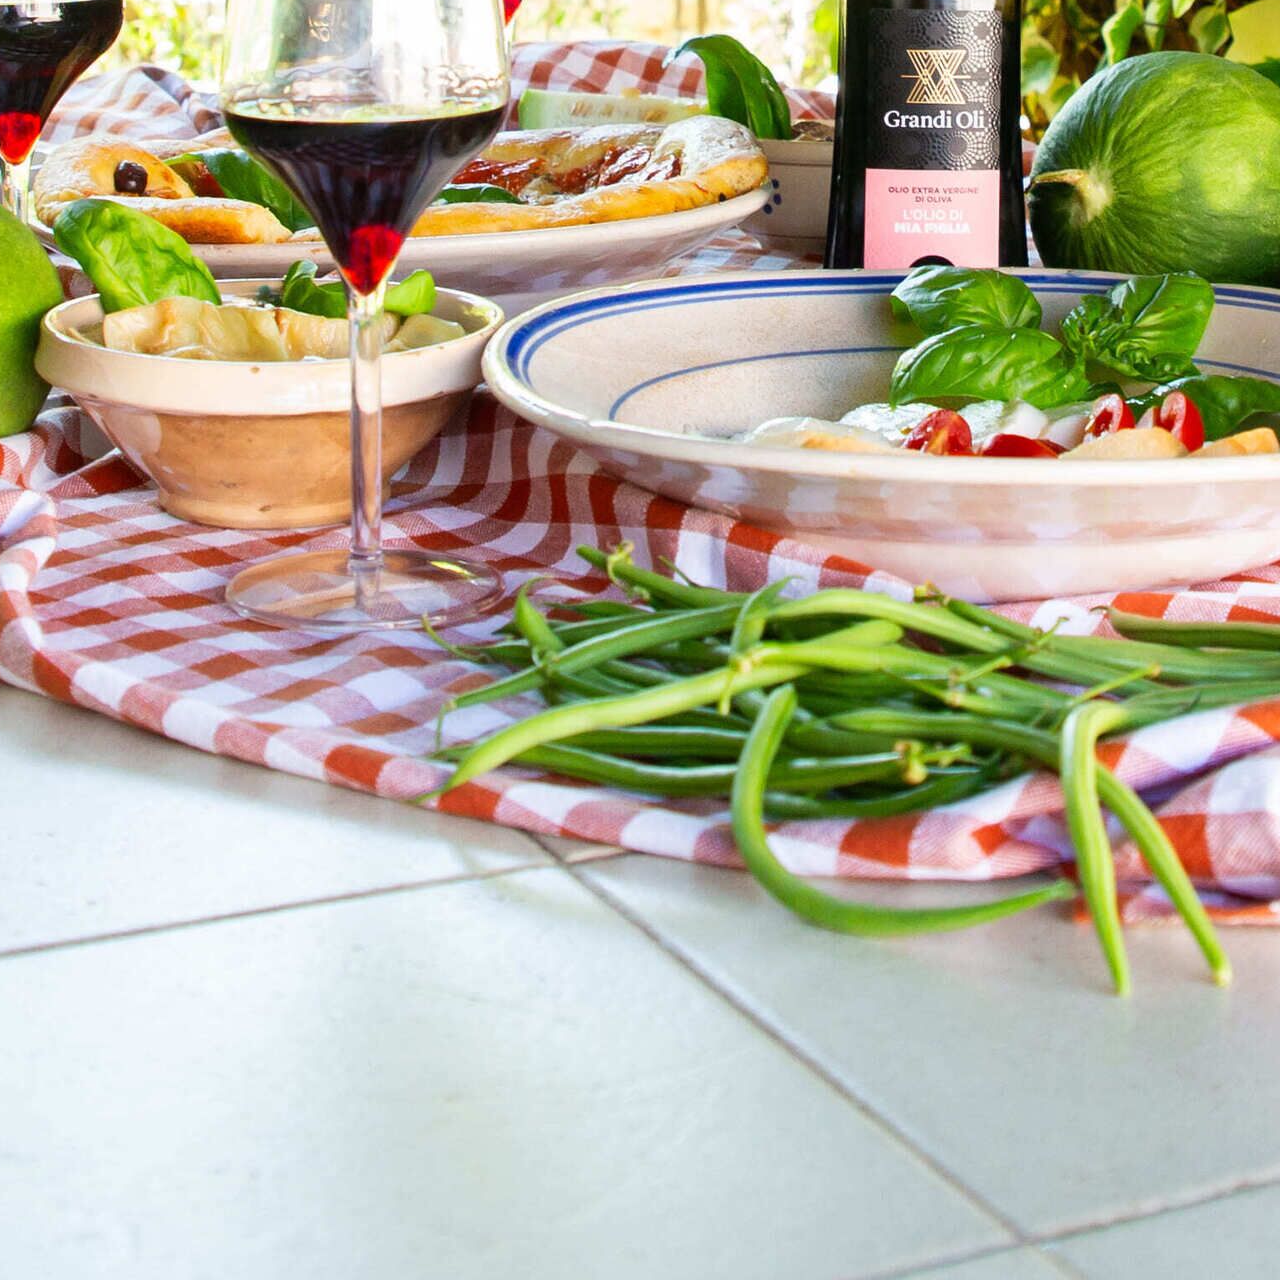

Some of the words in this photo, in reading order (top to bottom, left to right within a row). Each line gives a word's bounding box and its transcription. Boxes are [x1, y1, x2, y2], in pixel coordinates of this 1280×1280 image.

[883, 110, 952, 129] Grandi
[955, 110, 985, 129] Oli
[888, 186, 910, 194] OLIO
[911, 186, 940, 194] EXTRA
[915, 195, 924, 203] DI
[927, 195, 952, 203] OLIVA
